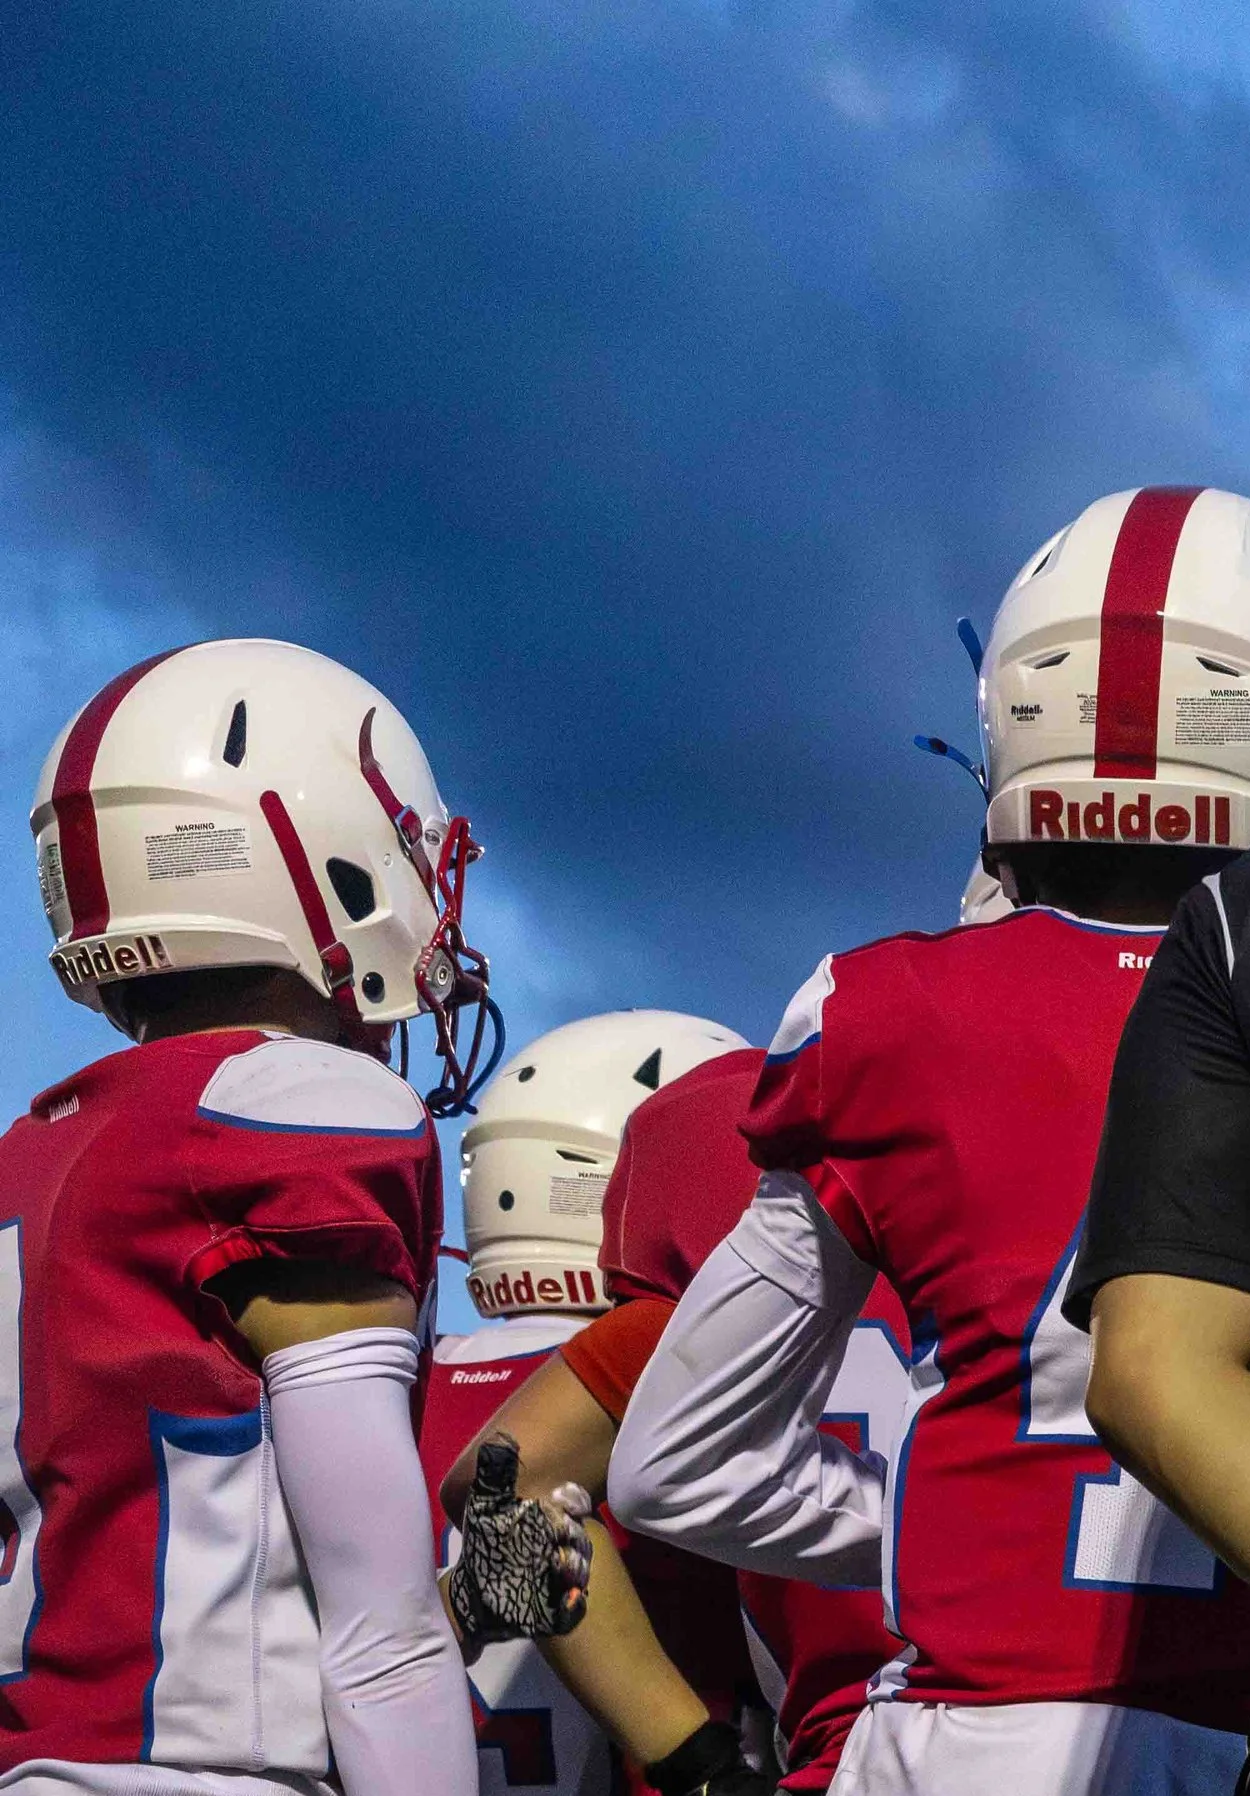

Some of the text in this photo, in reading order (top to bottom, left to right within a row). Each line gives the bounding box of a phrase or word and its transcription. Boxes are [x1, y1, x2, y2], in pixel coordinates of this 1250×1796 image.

[1209, 689, 1250, 698] WARNING
[1011, 704, 1040, 716] Riddell
[1029, 789, 1231, 846] Riddell
[174, 822, 216, 833] WARNING
[51, 933, 175, 985] Riddell
[467, 1269, 598, 1312] Riddell
[450, 1369, 513, 1386] Riddell
